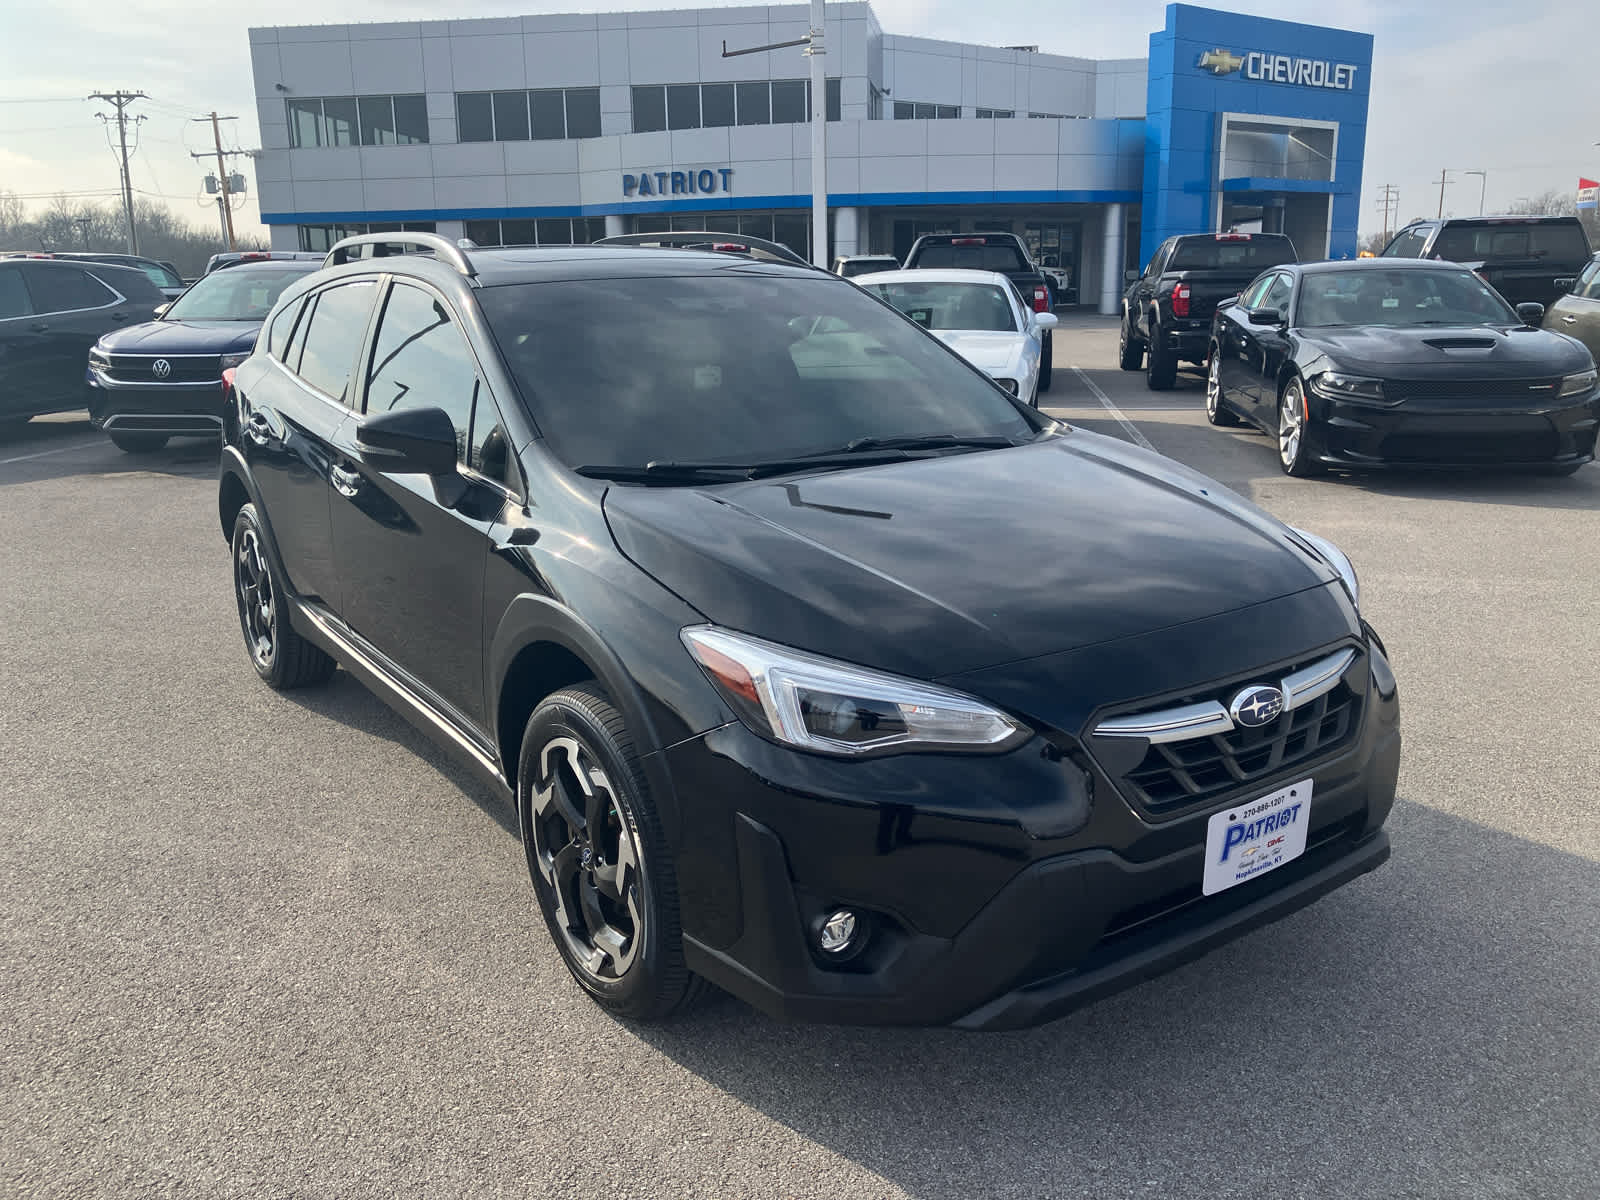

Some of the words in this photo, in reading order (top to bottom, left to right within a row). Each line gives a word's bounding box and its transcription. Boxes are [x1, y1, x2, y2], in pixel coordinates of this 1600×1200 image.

[1247, 52, 1357, 89] CHEVROLET
[622, 168, 734, 197] PATRIOT
[1219, 803, 1302, 864] PATRIOT
[1267, 835, 1285, 848] GMC
